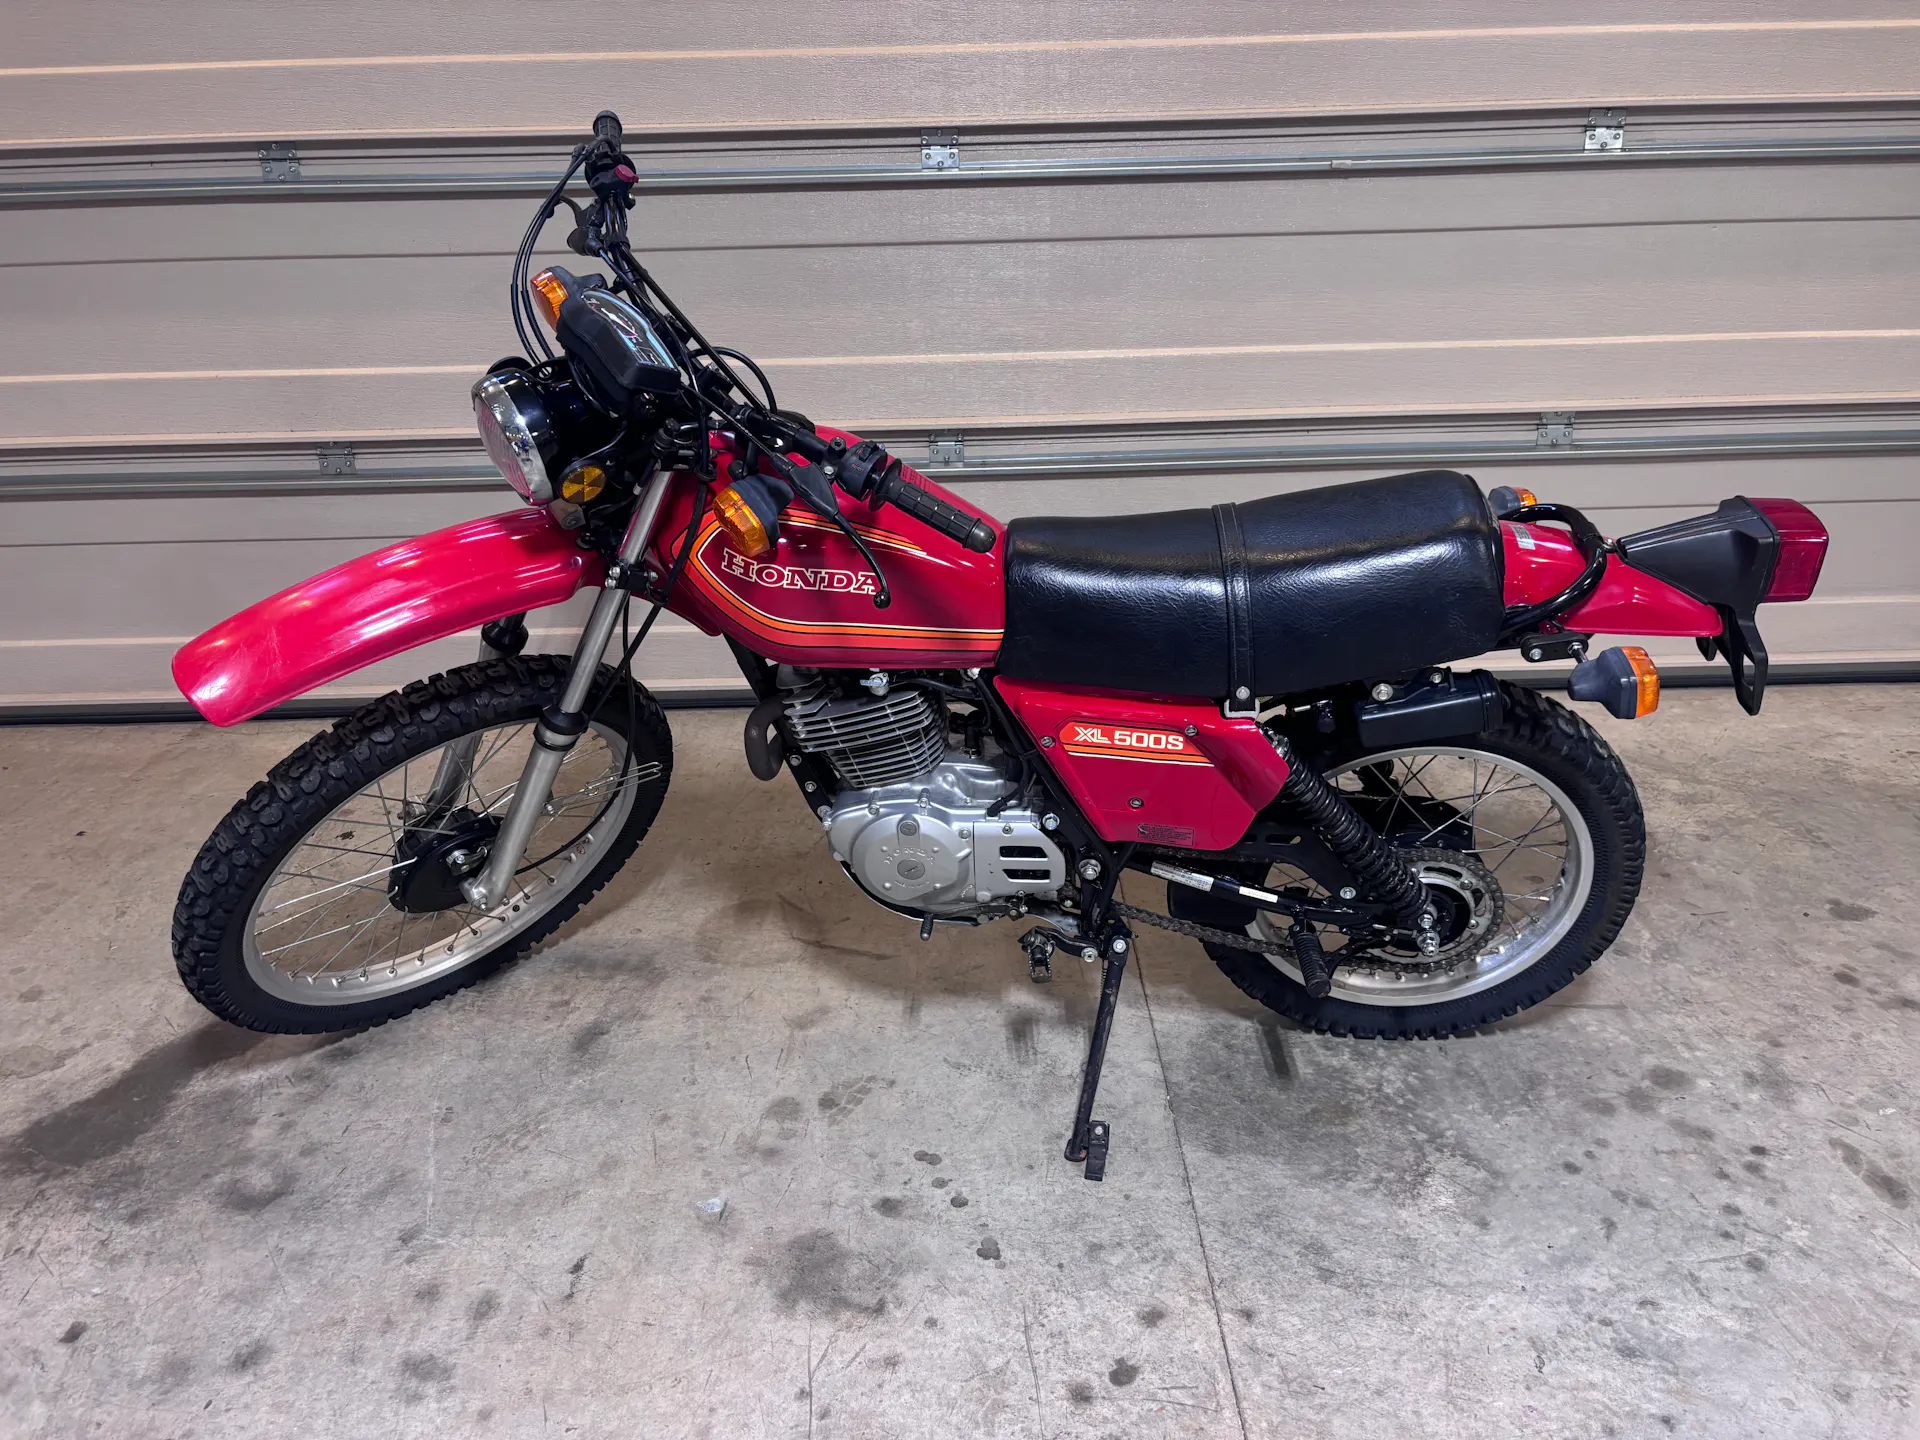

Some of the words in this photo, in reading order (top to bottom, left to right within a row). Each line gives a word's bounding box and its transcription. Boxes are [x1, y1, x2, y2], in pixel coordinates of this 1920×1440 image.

[721, 547, 877, 596] HONDA
[1074, 726, 1112, 744] XL
[1114, 730, 1184, 750] 500S
